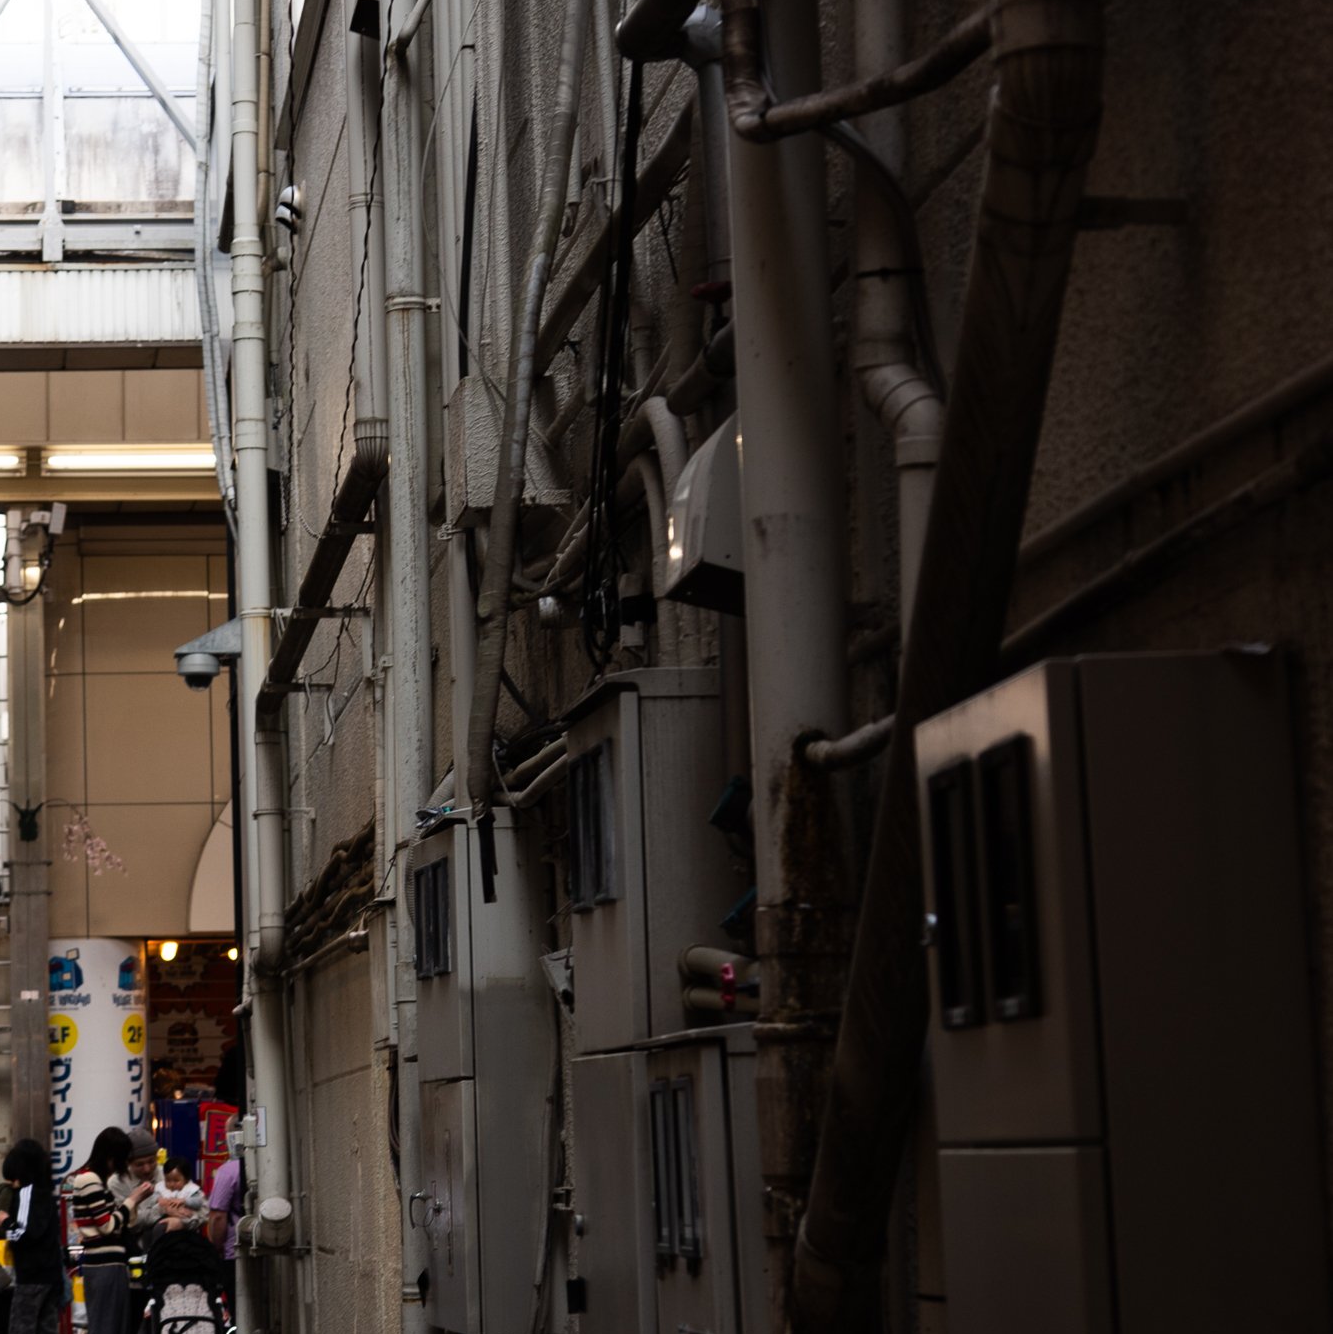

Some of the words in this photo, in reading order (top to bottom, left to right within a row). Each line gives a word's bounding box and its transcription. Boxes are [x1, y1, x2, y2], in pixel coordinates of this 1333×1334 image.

[127, 1025, 142, 1043] 2F
[49, 1057, 73, 1184] ヴィレッジ
